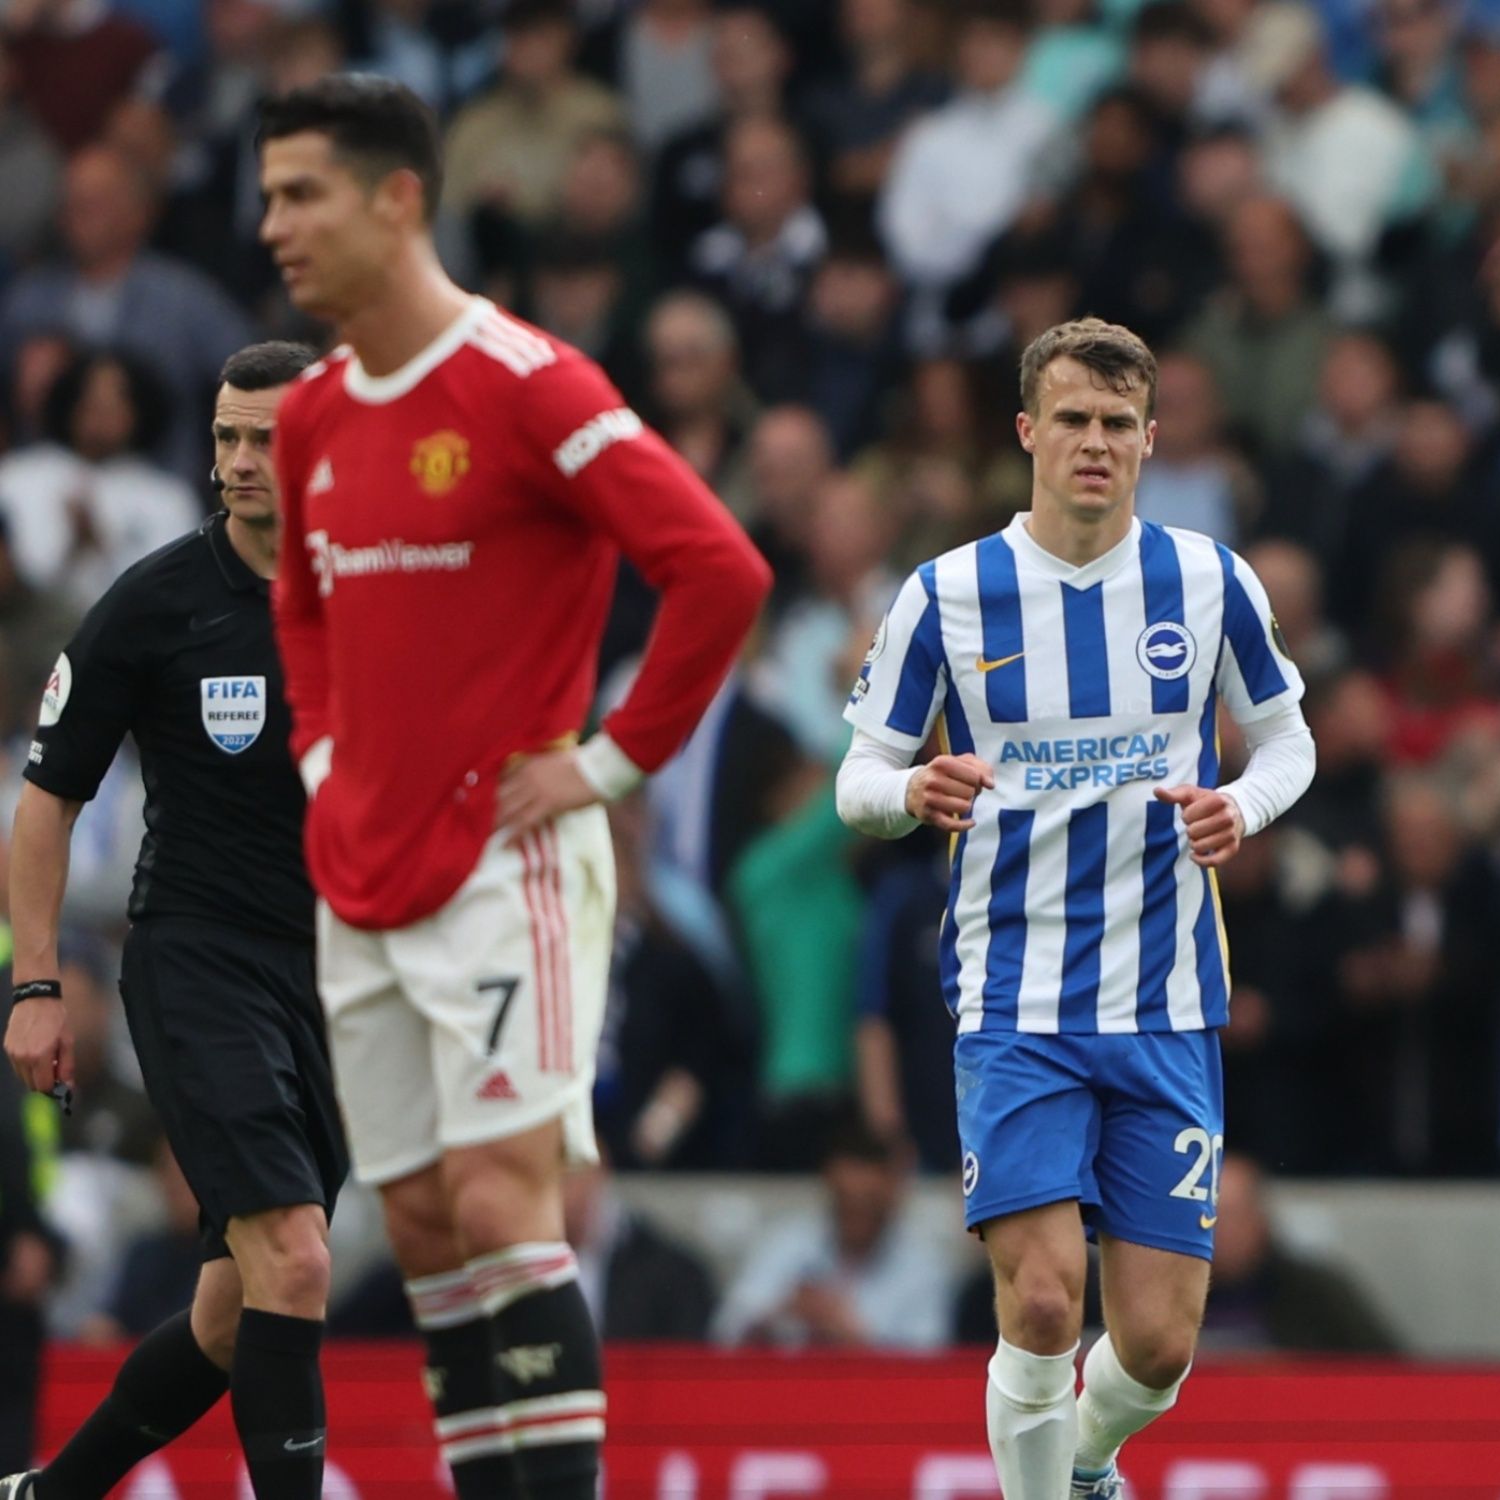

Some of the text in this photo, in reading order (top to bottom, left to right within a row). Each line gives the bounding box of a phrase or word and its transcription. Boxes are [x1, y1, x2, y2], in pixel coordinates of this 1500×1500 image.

[207, 680, 259, 700] FIFA
[207, 710, 260, 721] REFEREE
[222, 735, 246, 745] 2022
[1000, 732, 1171, 764] AMERICAN
[1024, 757, 1170, 791] EXPRESS
[477, 976, 523, 1056] 7
